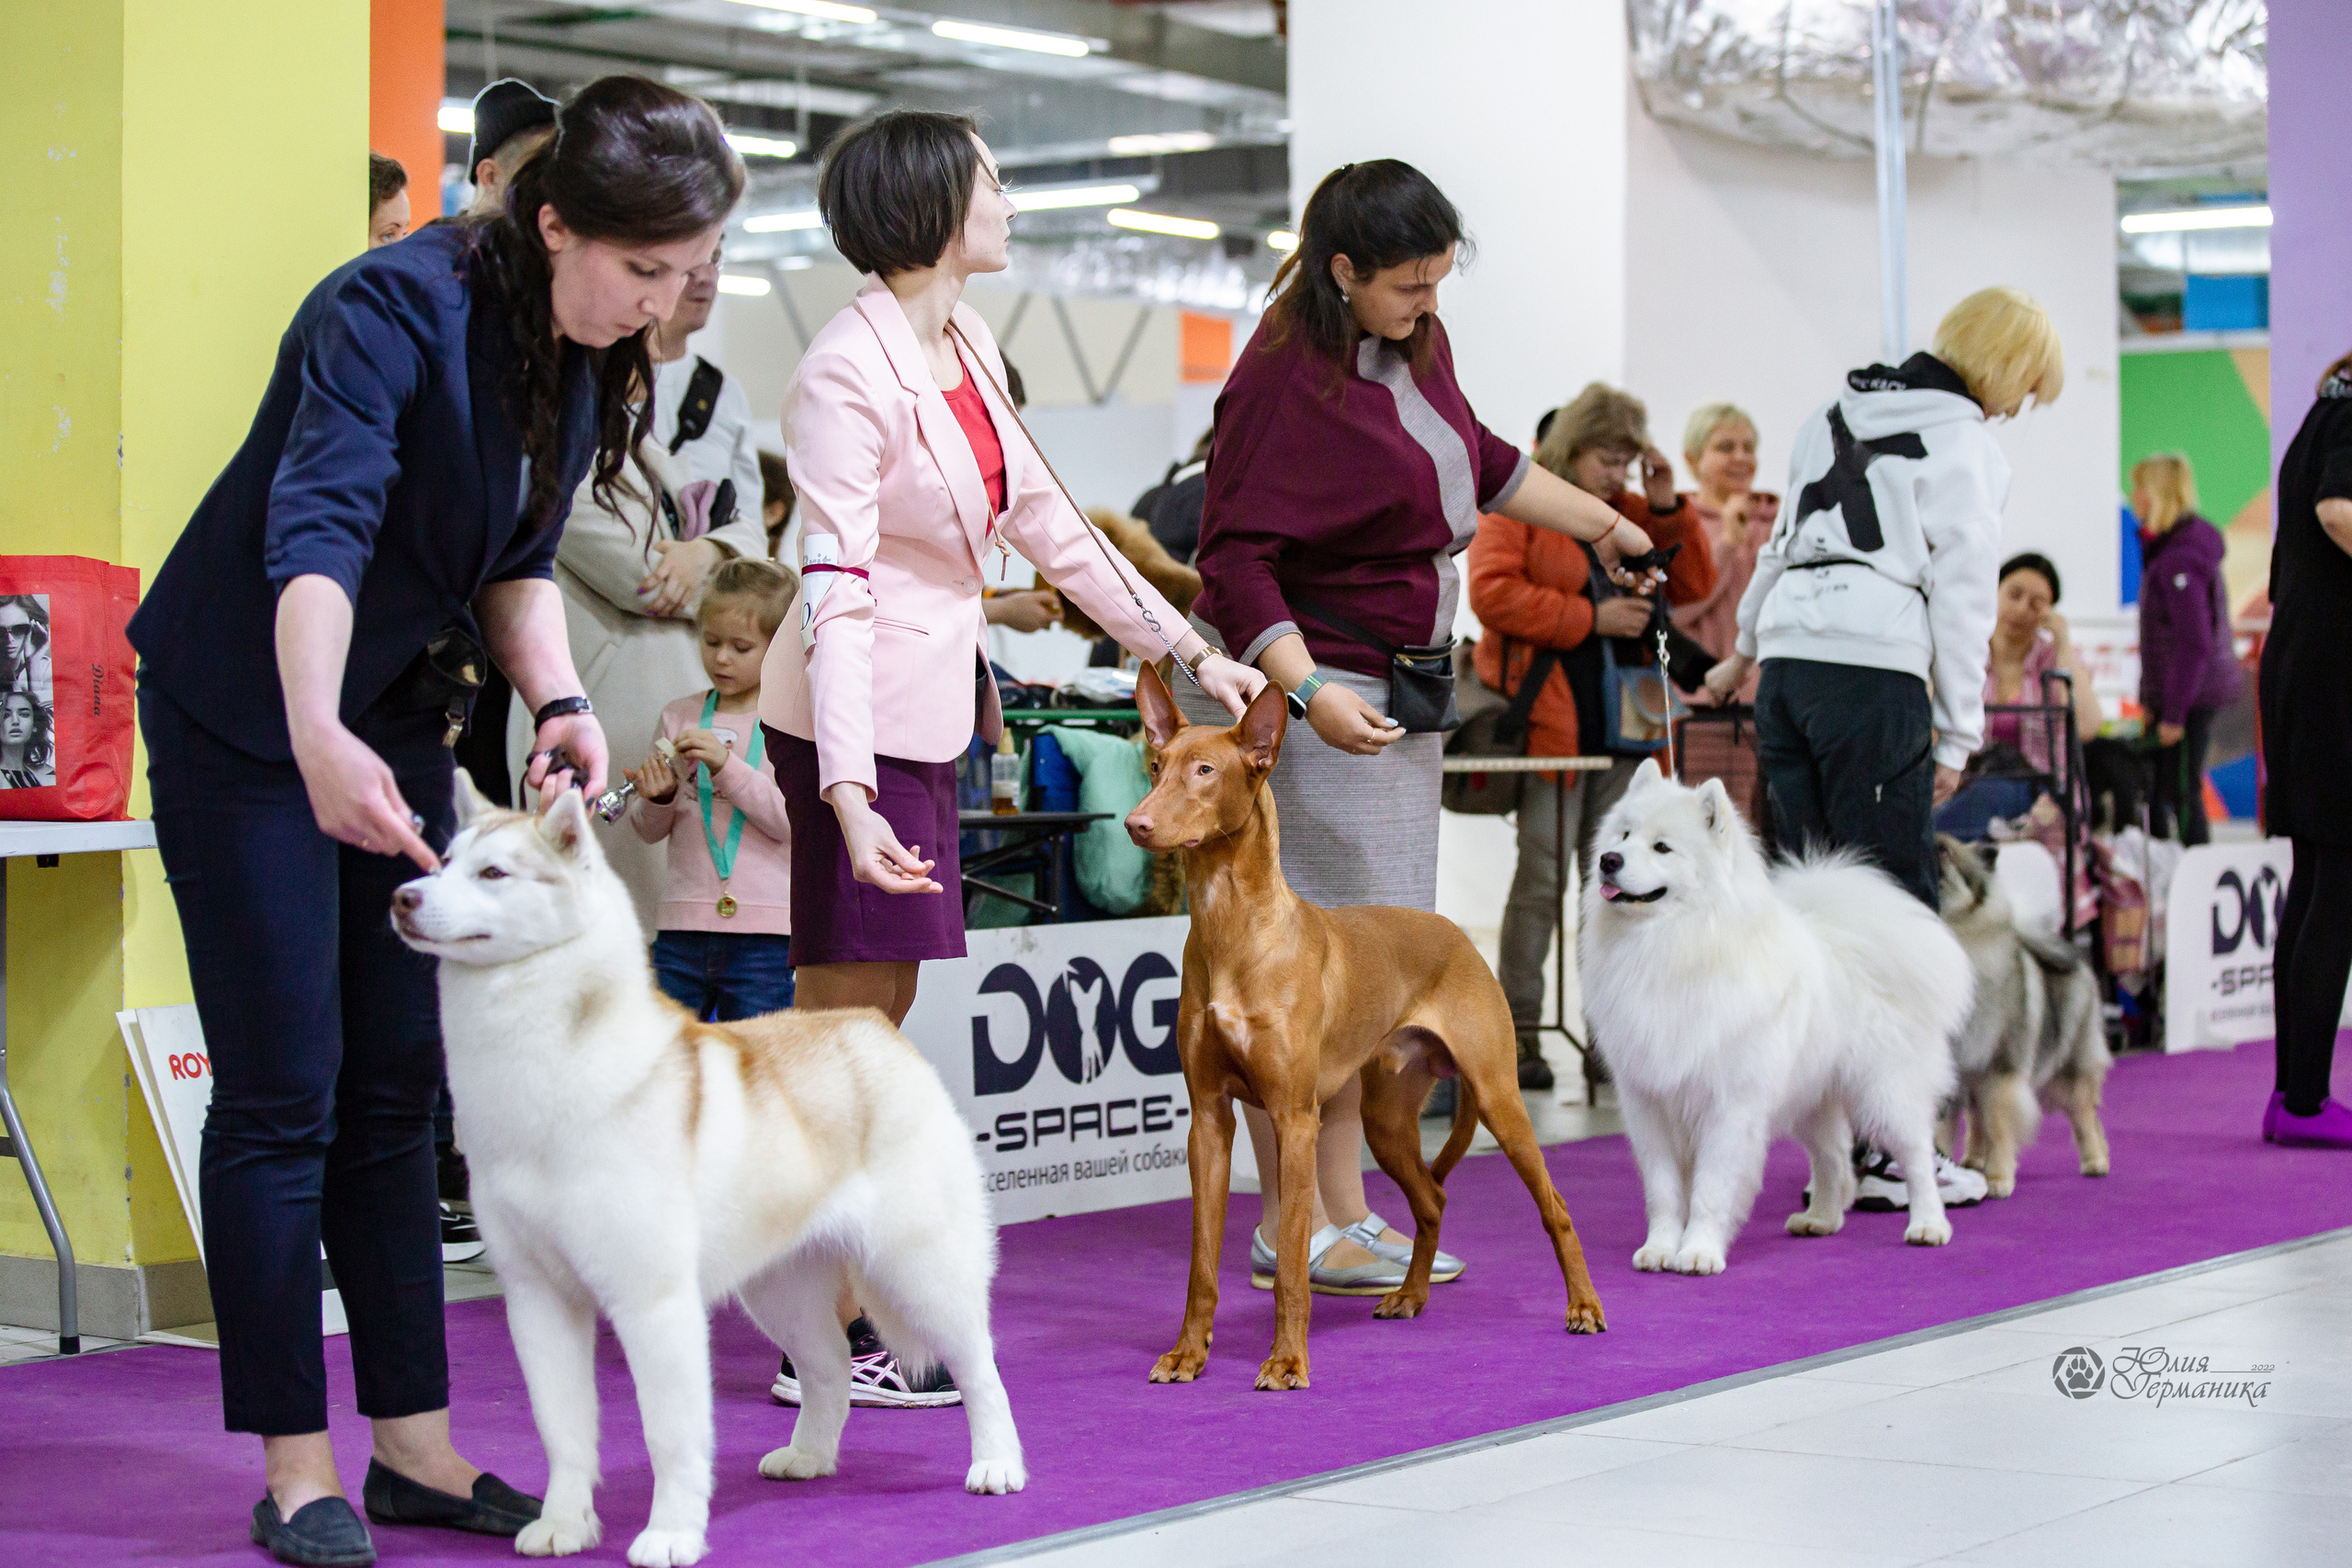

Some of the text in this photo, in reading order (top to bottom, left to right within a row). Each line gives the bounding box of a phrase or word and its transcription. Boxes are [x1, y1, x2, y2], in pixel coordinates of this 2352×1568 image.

[92, 663, 104, 716] Diana
[971, 952, 1183, 1097] DOG
[979, 1162, 1069, 1193] селенная
[1074, 1149, 1129, 1181] вашей
